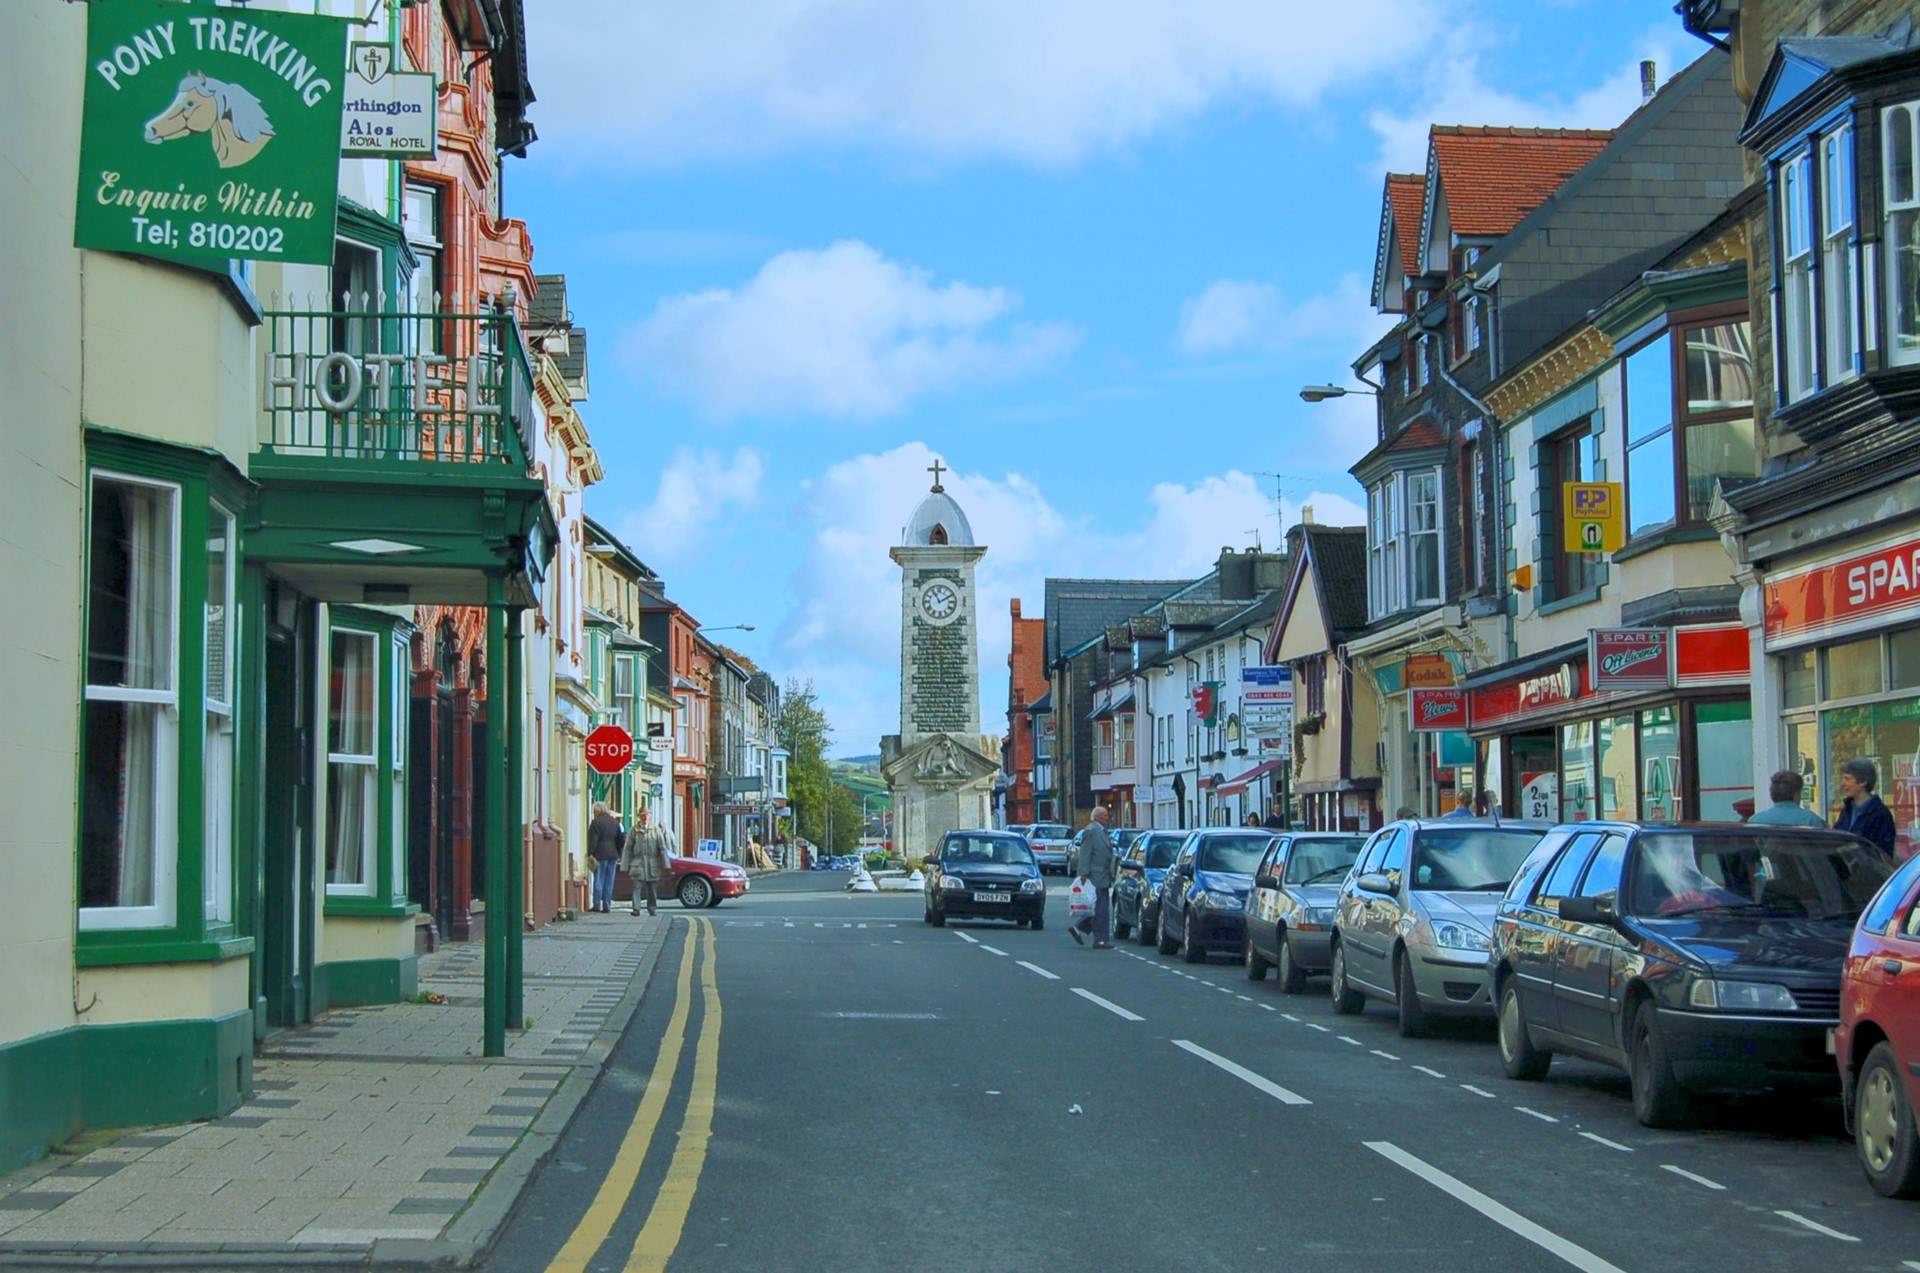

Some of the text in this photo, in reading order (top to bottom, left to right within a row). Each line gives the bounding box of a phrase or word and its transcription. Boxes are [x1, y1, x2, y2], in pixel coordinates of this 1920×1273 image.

[96, 17, 331, 108] PONY TREKKING
[343, 99, 421, 115] rthington
[347, 119, 394, 136] Ales
[349, 137, 426, 148] ROYAL HOTEL
[97, 170, 316, 219] Enquire Within
[189, 223, 284, 253] 810202
[263, 352, 502, 415] HOTEL
[1602, 633, 1646, 642] SPAR
[1408, 669, 1448, 681] Kodak
[1421, 701, 1457, 717] News
[587, 743, 630, 757] STOP
[1531, 785, 1538, 800] 2
[1532, 801, 1548, 818] £1
